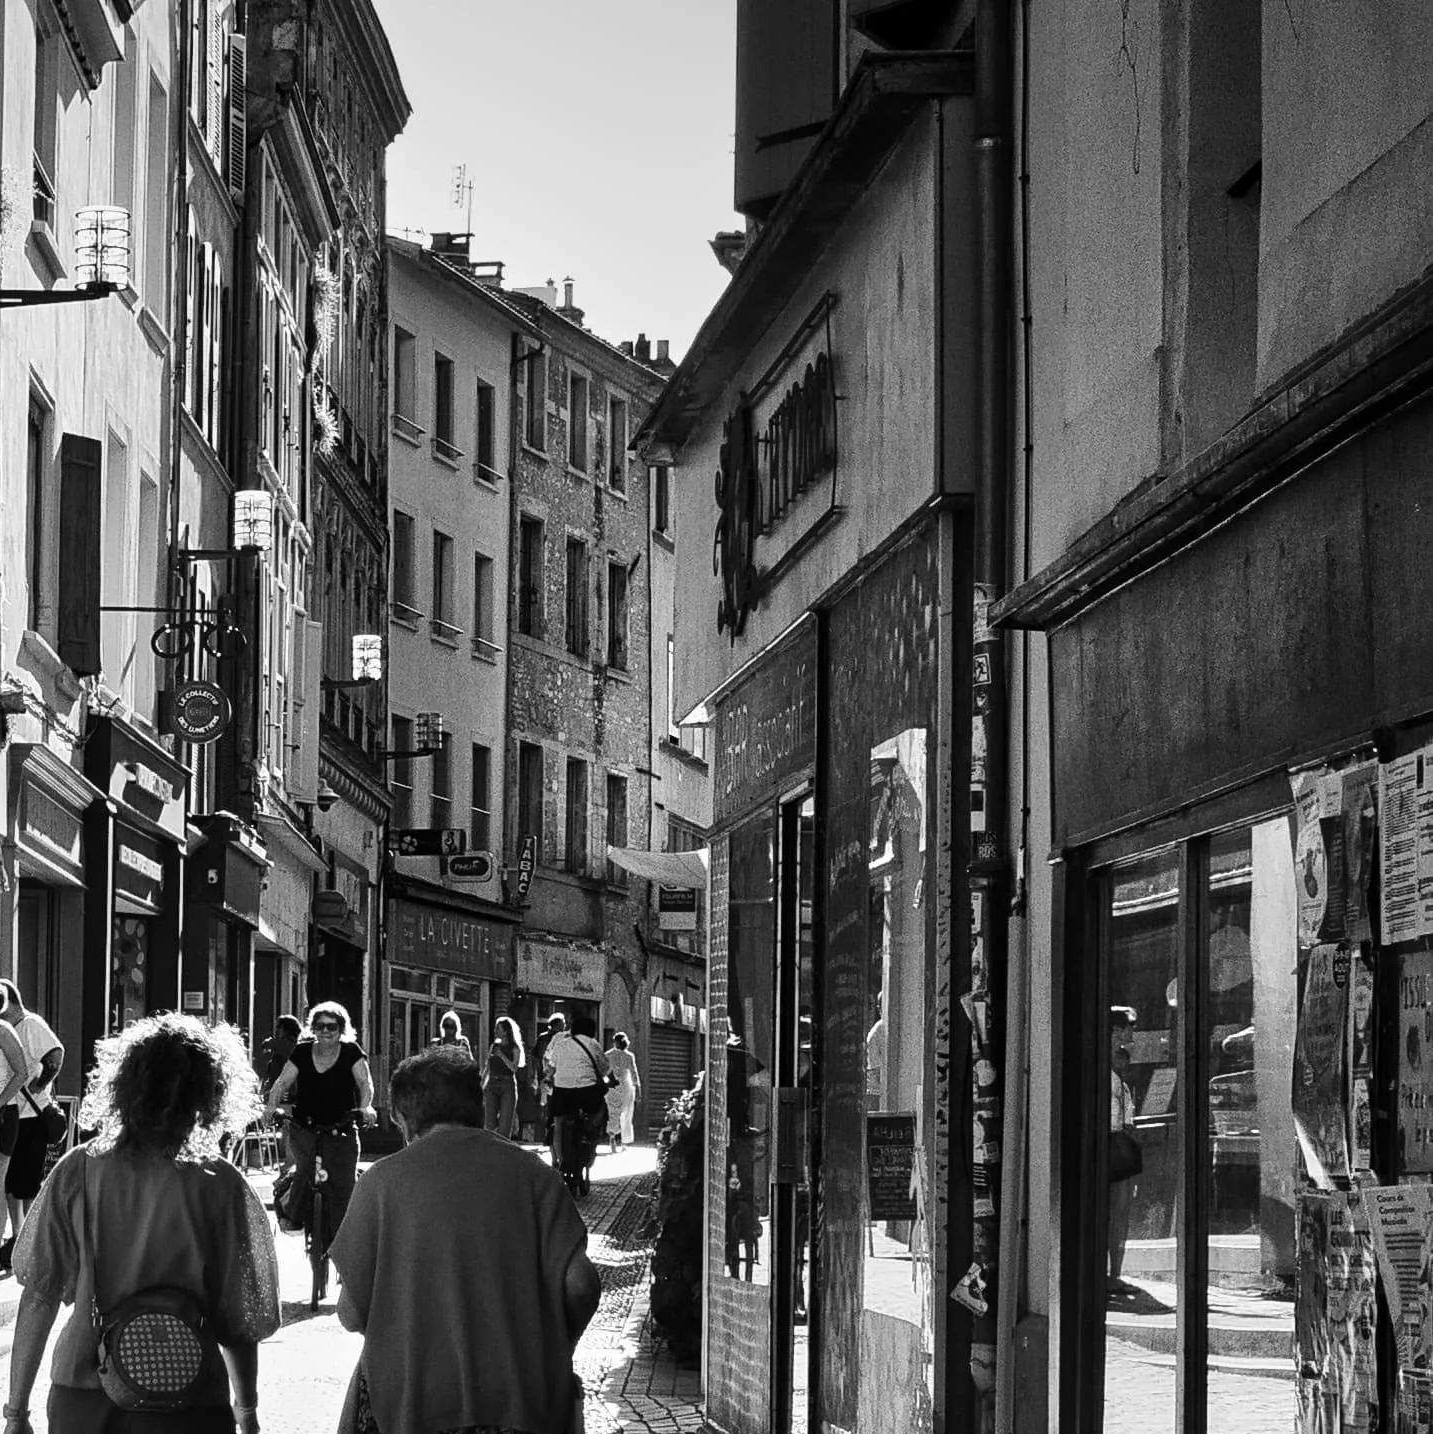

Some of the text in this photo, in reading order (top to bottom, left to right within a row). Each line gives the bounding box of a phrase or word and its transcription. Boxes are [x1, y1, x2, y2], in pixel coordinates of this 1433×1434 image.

[518, 837, 534, 893] TABAC
[420, 913, 435, 943] LA
[440, 916, 491, 954] CIVETTE
[1376, 1194, 1396, 1203] Cours
